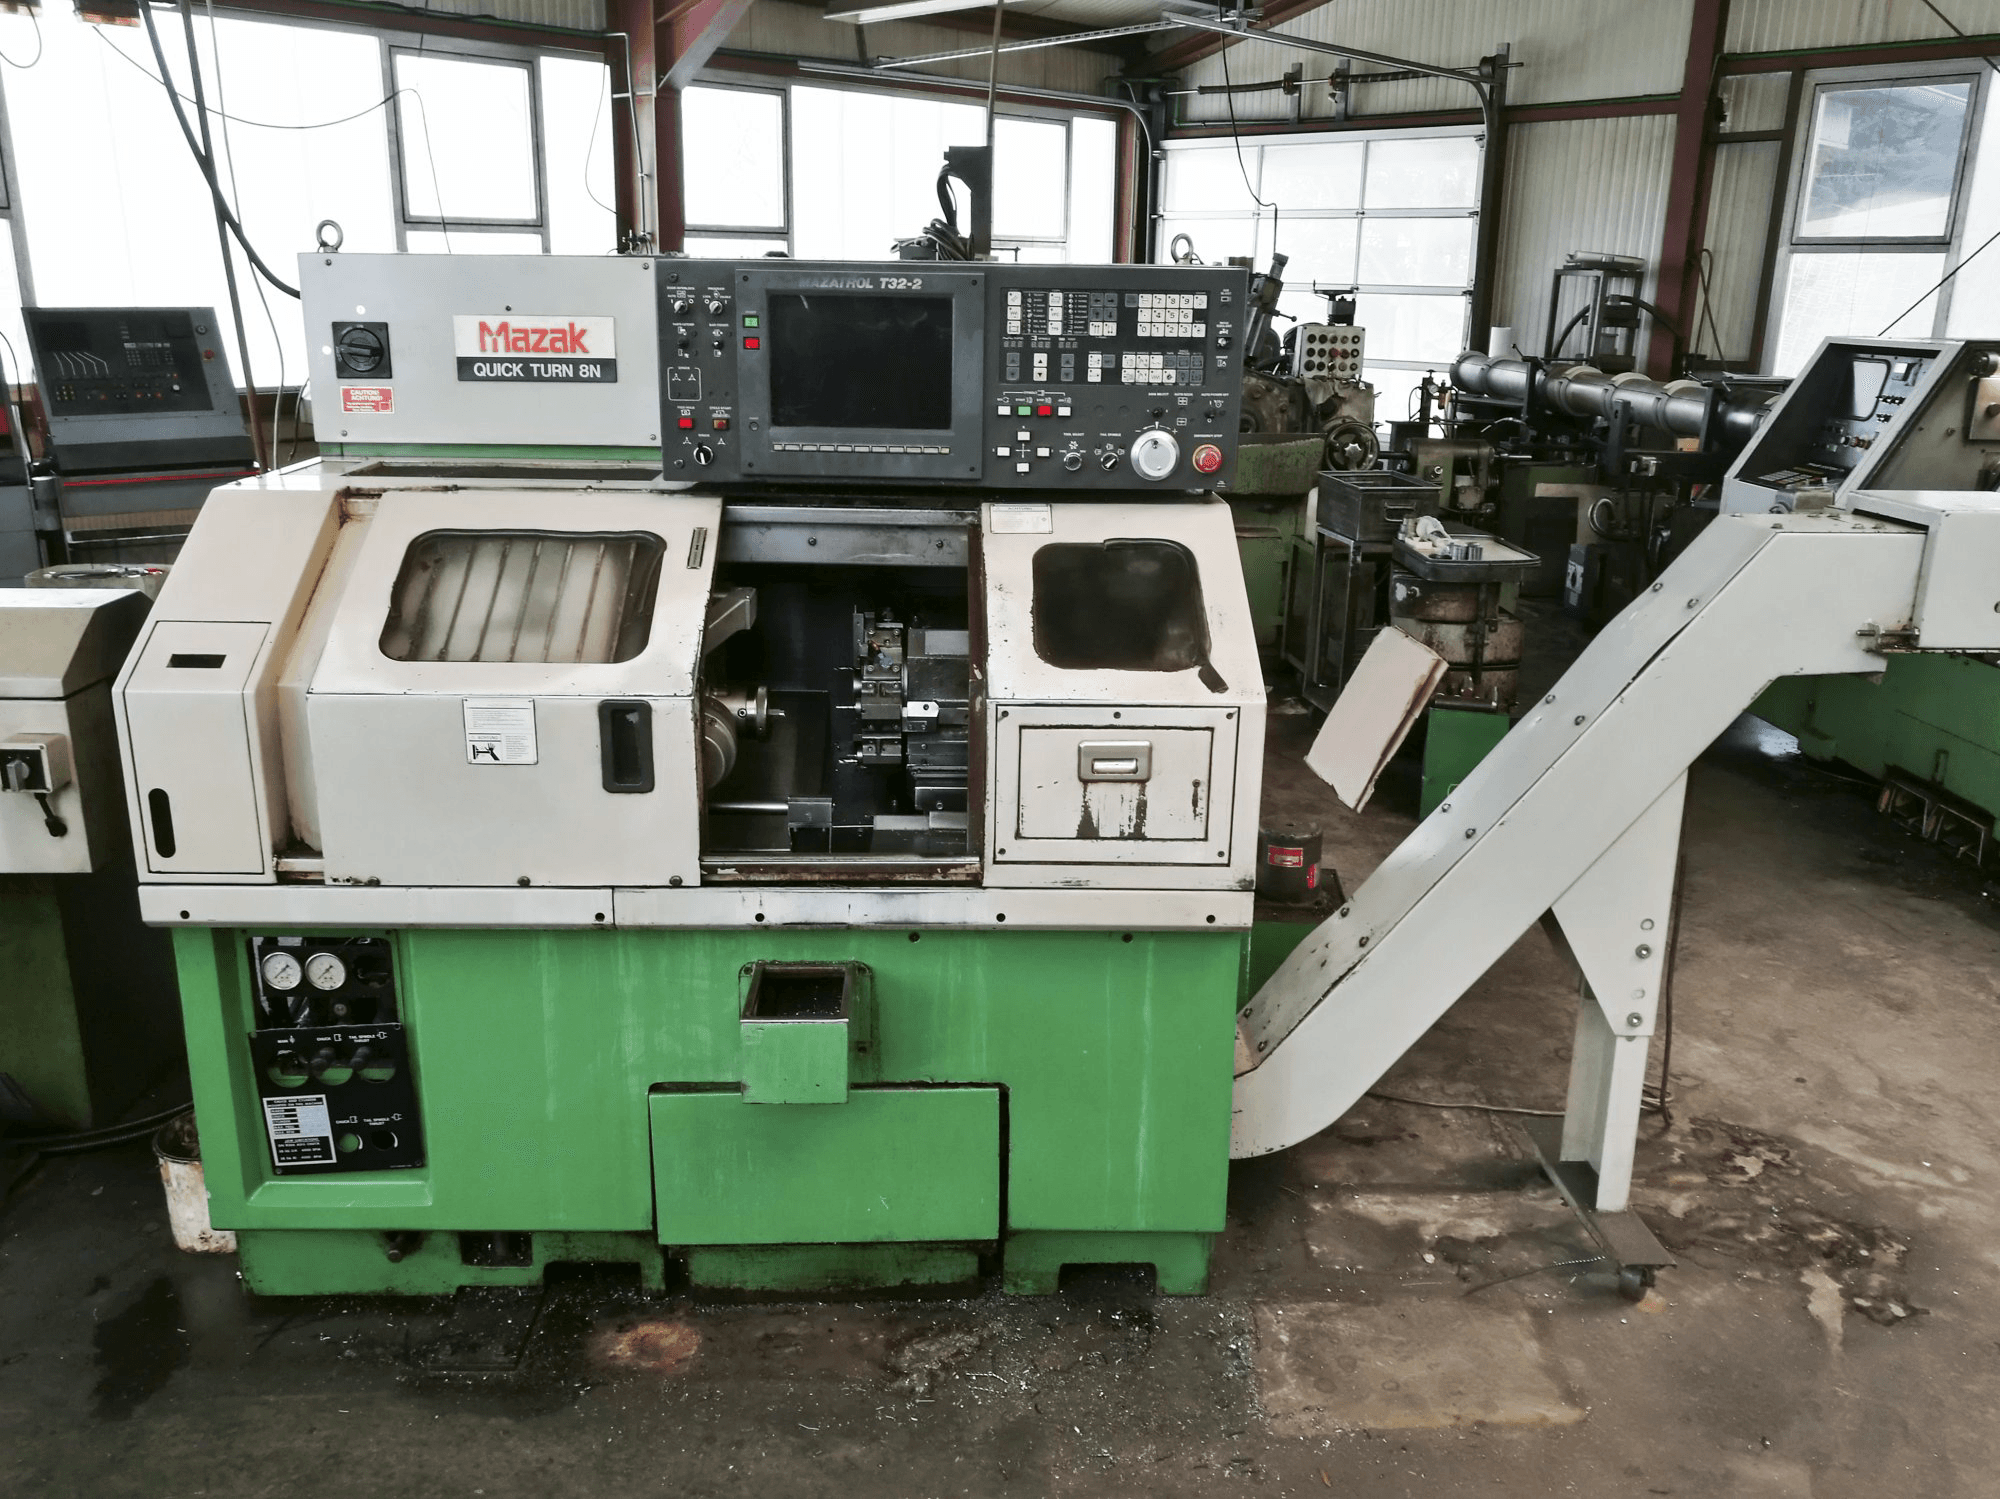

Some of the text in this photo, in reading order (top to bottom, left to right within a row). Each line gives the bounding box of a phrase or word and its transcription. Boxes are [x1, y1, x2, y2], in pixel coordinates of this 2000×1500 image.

[799, 278, 923, 290] MAZATROL T32-2
[479, 321, 590, 353] Mazak
[473, 362, 601, 379] QUICK TURN 8N
